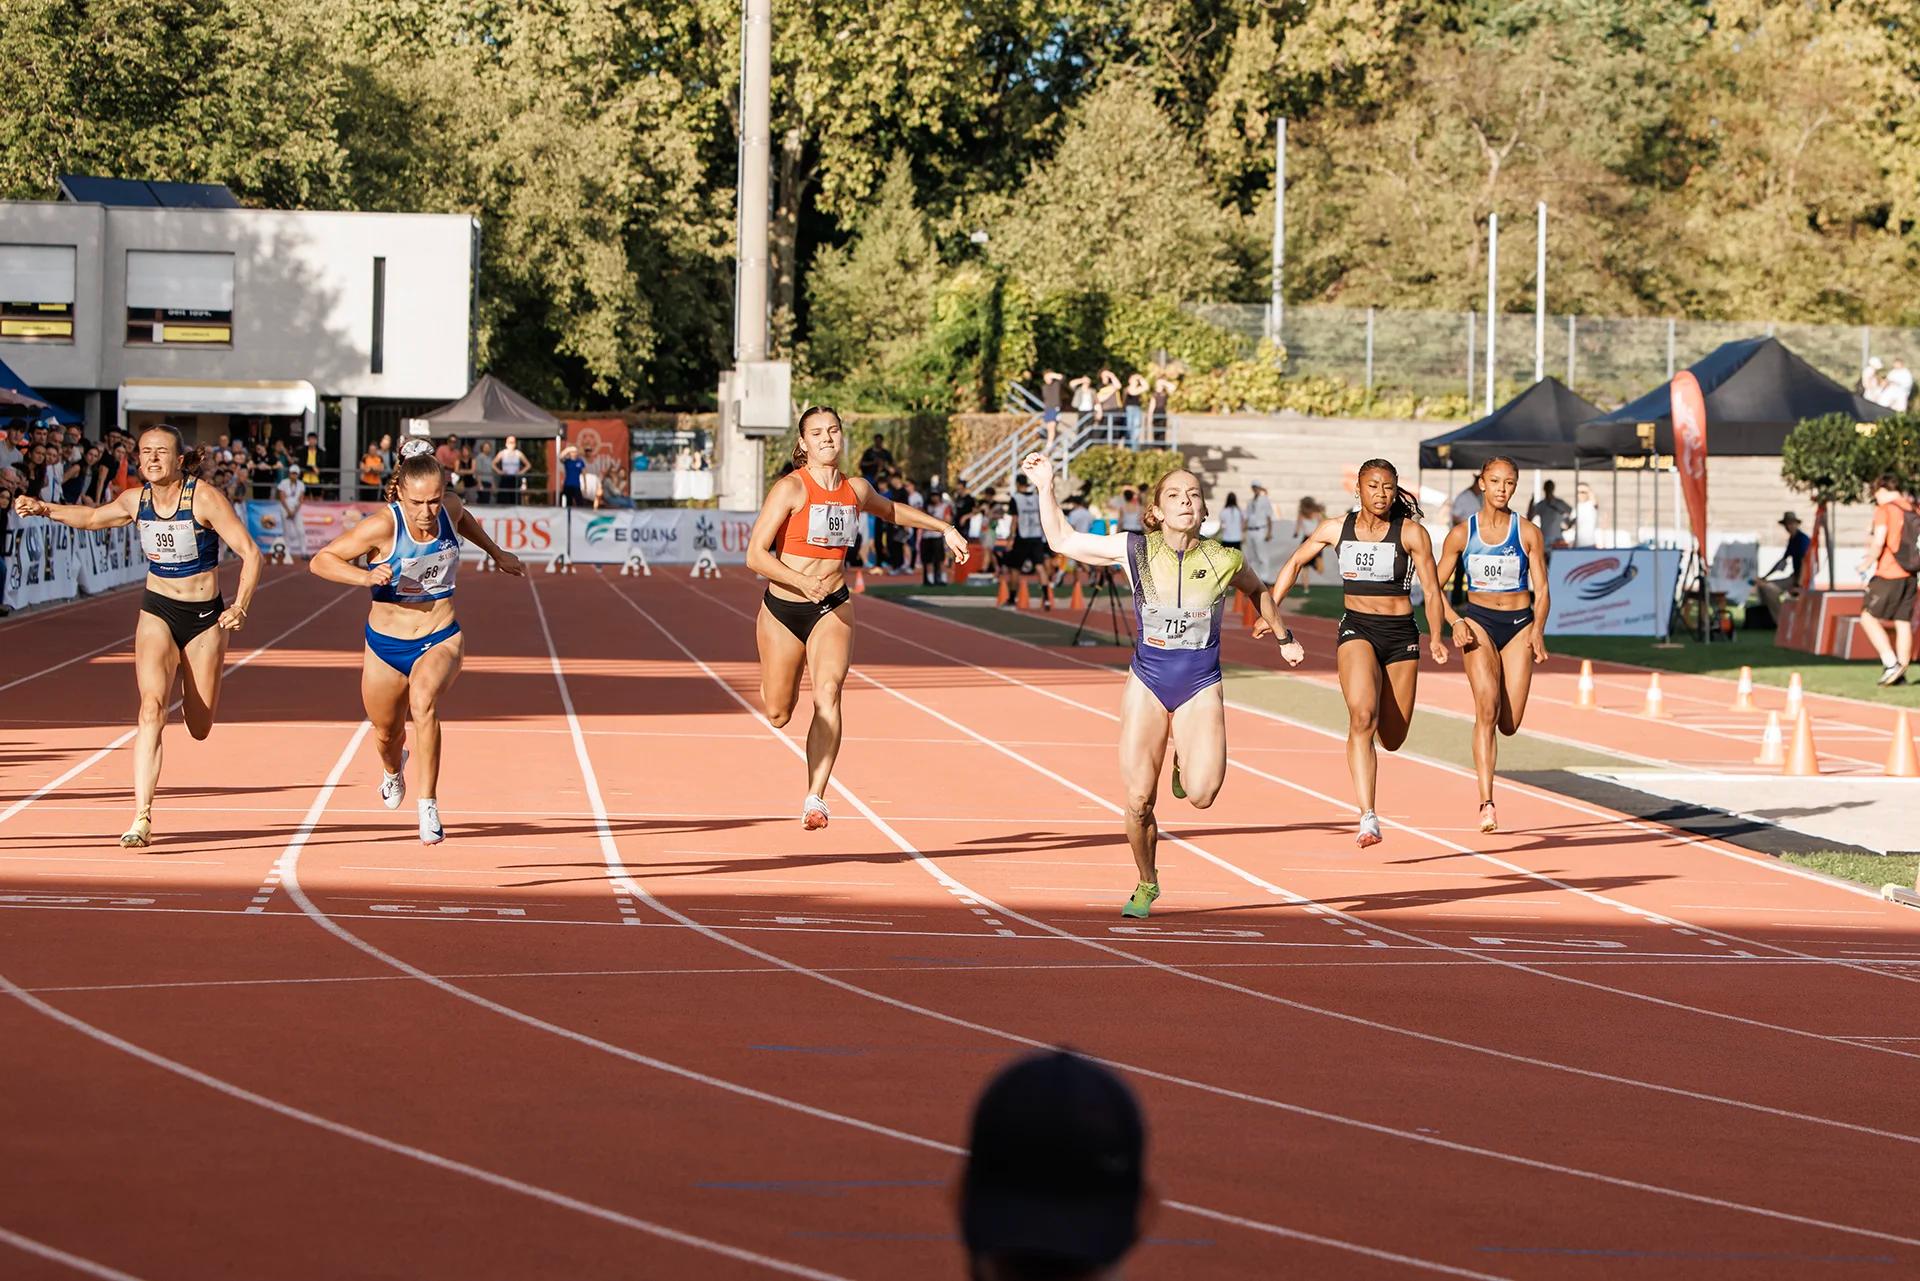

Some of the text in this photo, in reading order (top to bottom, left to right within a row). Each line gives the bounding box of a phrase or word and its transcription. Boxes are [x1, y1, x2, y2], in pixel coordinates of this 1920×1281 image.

[828, 516, 844, 531] 691
[155, 533, 175, 548] 399
[615, 528, 678, 543] EQUANS
[271, 543, 286, 560] 8
[1355, 552, 1375, 567] 635
[424, 565, 439, 580] 58
[1484, 565, 1502, 577] 804
[1165, 619, 1187, 634] 715
